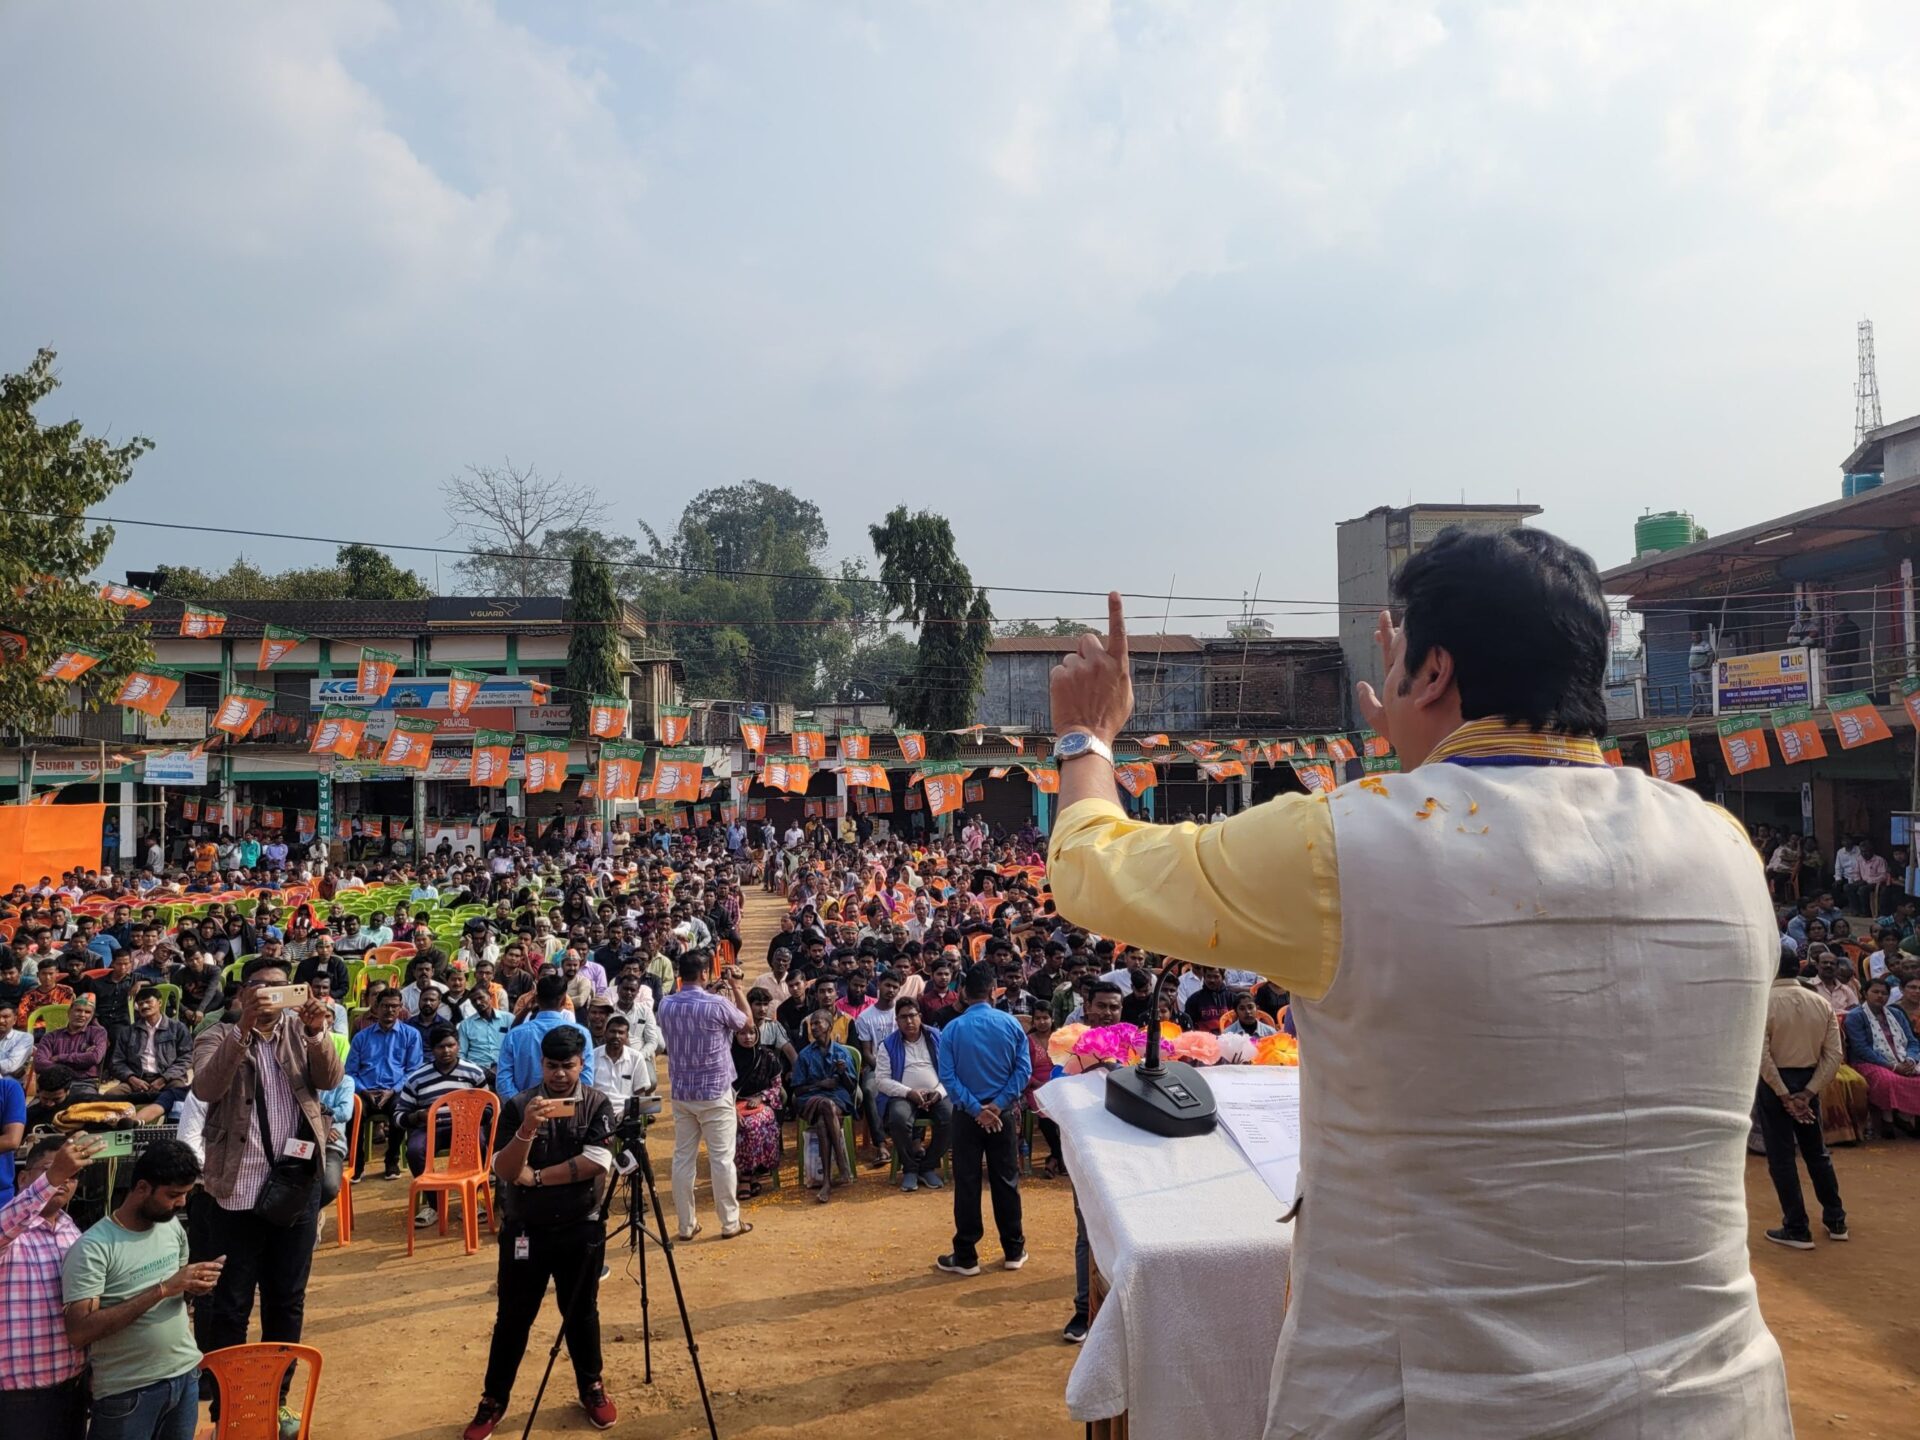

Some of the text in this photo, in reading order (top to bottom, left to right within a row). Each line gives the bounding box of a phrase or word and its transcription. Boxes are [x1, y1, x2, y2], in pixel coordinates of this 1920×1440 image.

[1790, 654, 1803, 666] LIC
[319, 681, 357, 694] KE
[434, 747, 525, 757] ELECTRICAL CEN
